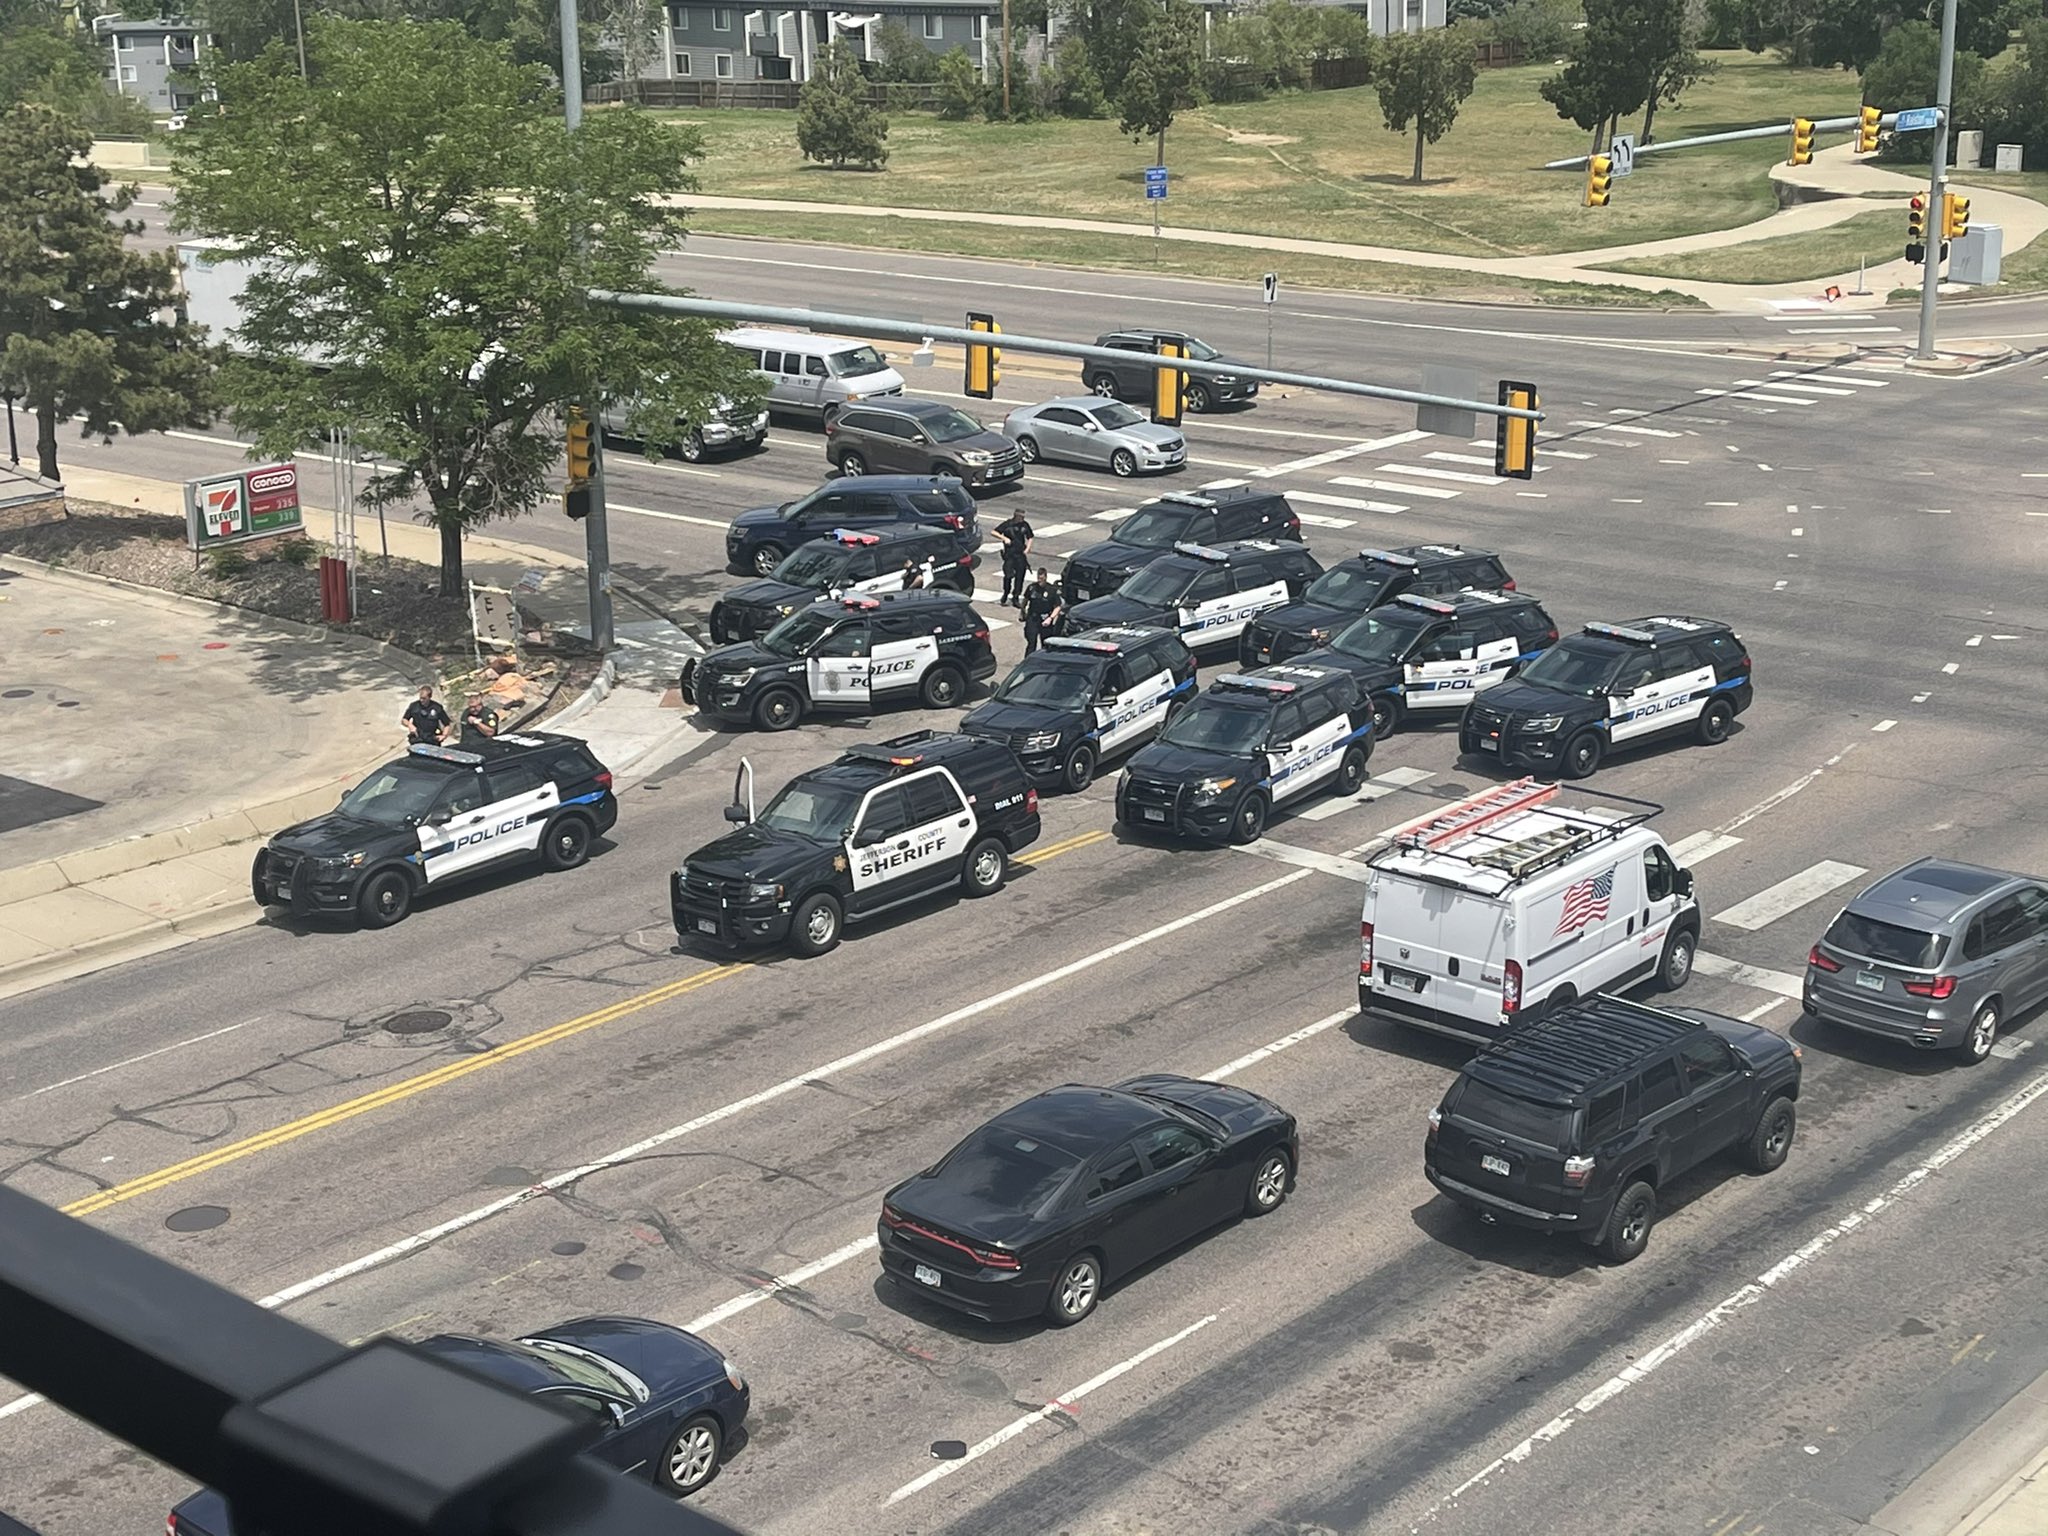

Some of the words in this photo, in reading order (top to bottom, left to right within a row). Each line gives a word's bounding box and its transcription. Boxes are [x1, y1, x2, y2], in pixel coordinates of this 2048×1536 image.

[1116, 698, 1155, 727] POLICE
[1636, 694, 1689, 719] POLICE
[1290, 745, 1331, 775] POLICE
[456, 816, 525, 850] POLICE
[917, 827, 944, 842] COUNTY
[860, 837, 947, 877] SHERIFF
